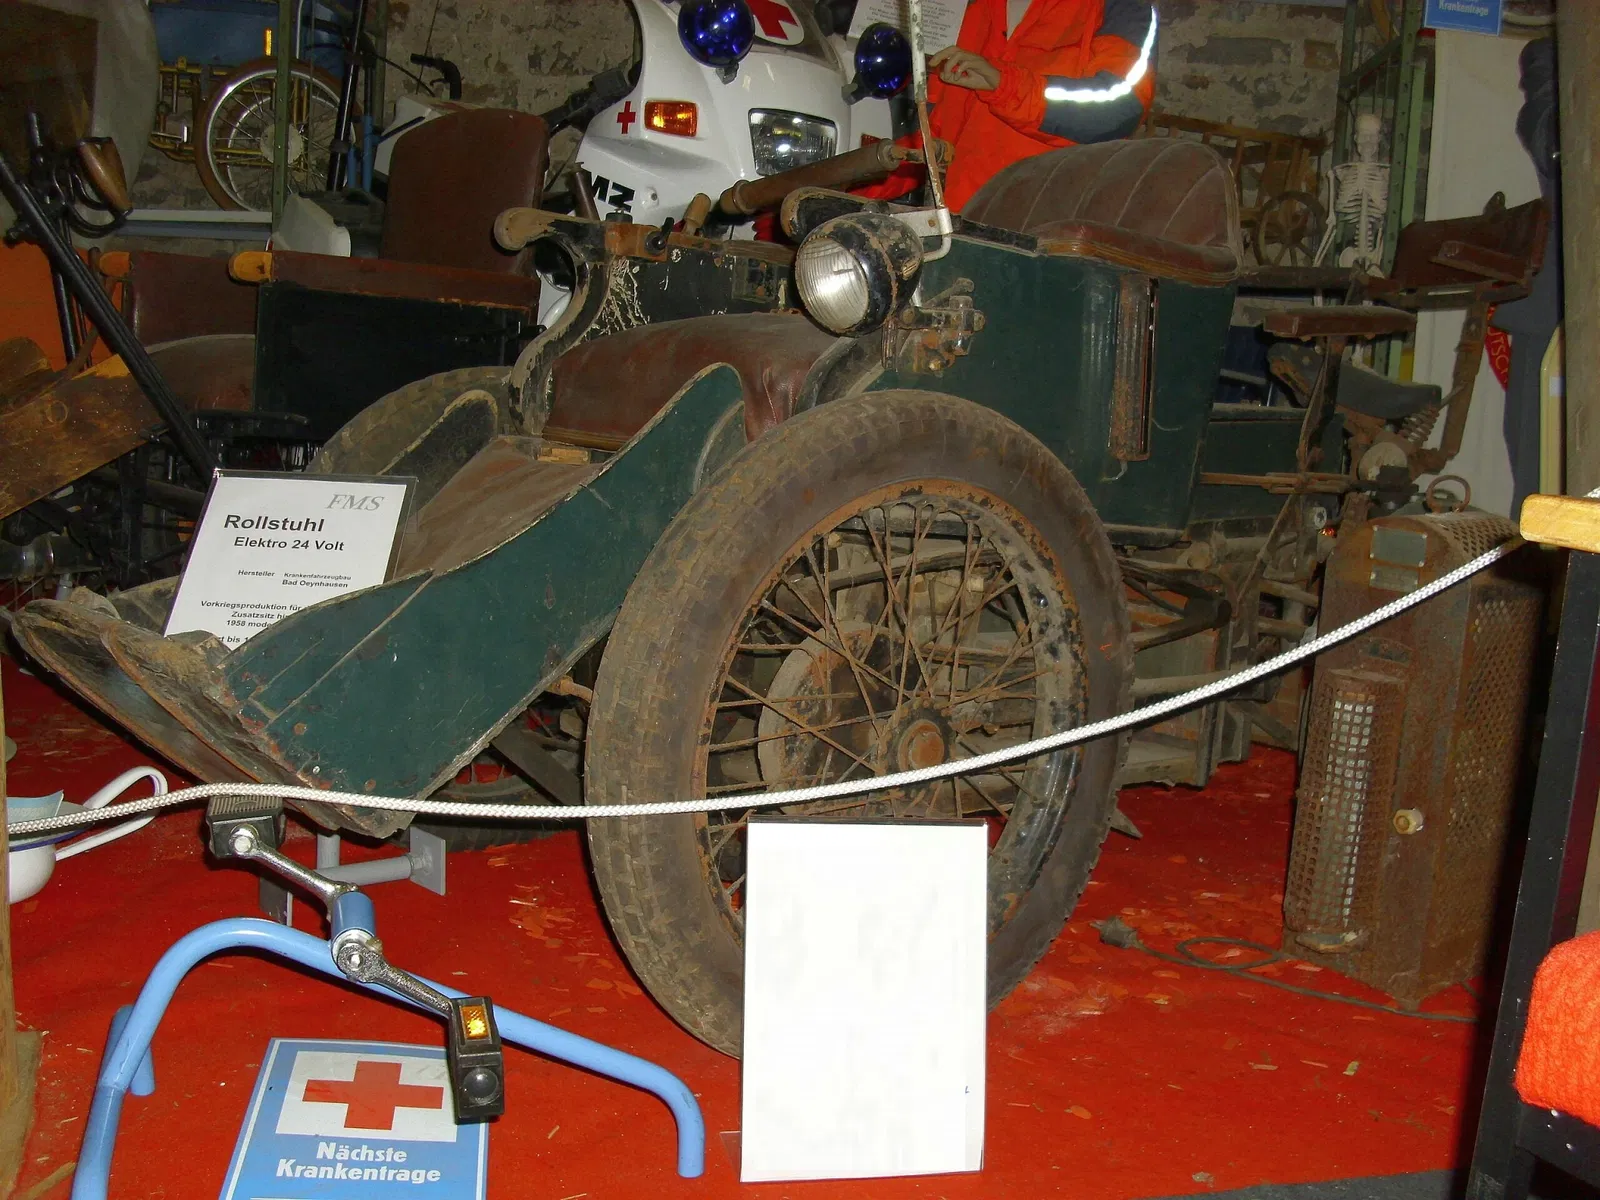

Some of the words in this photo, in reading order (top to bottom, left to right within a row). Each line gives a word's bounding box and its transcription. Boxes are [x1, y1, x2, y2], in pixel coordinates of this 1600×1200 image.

[326, 493, 384, 512] FMS
[223, 514, 325, 532] Rollstuhl
[233, 536, 288, 549] Elektro
[291, 539, 310, 550] 24
[315, 540, 345, 551] Volt
[237, 569, 276, 577] Hersteller
[283, 572, 352, 581] Krankenfahrzeugbau
[299, 579, 349, 588] Oeynhausen
[200, 600, 287, 610] Vorkriegsproduktion
[231, 611, 275, 619] Zusatzsitz
[226, 635, 241, 643] bis
[316, 1141, 408, 1162] Nächste
[276, 1158, 441, 1184] Krankentrage
